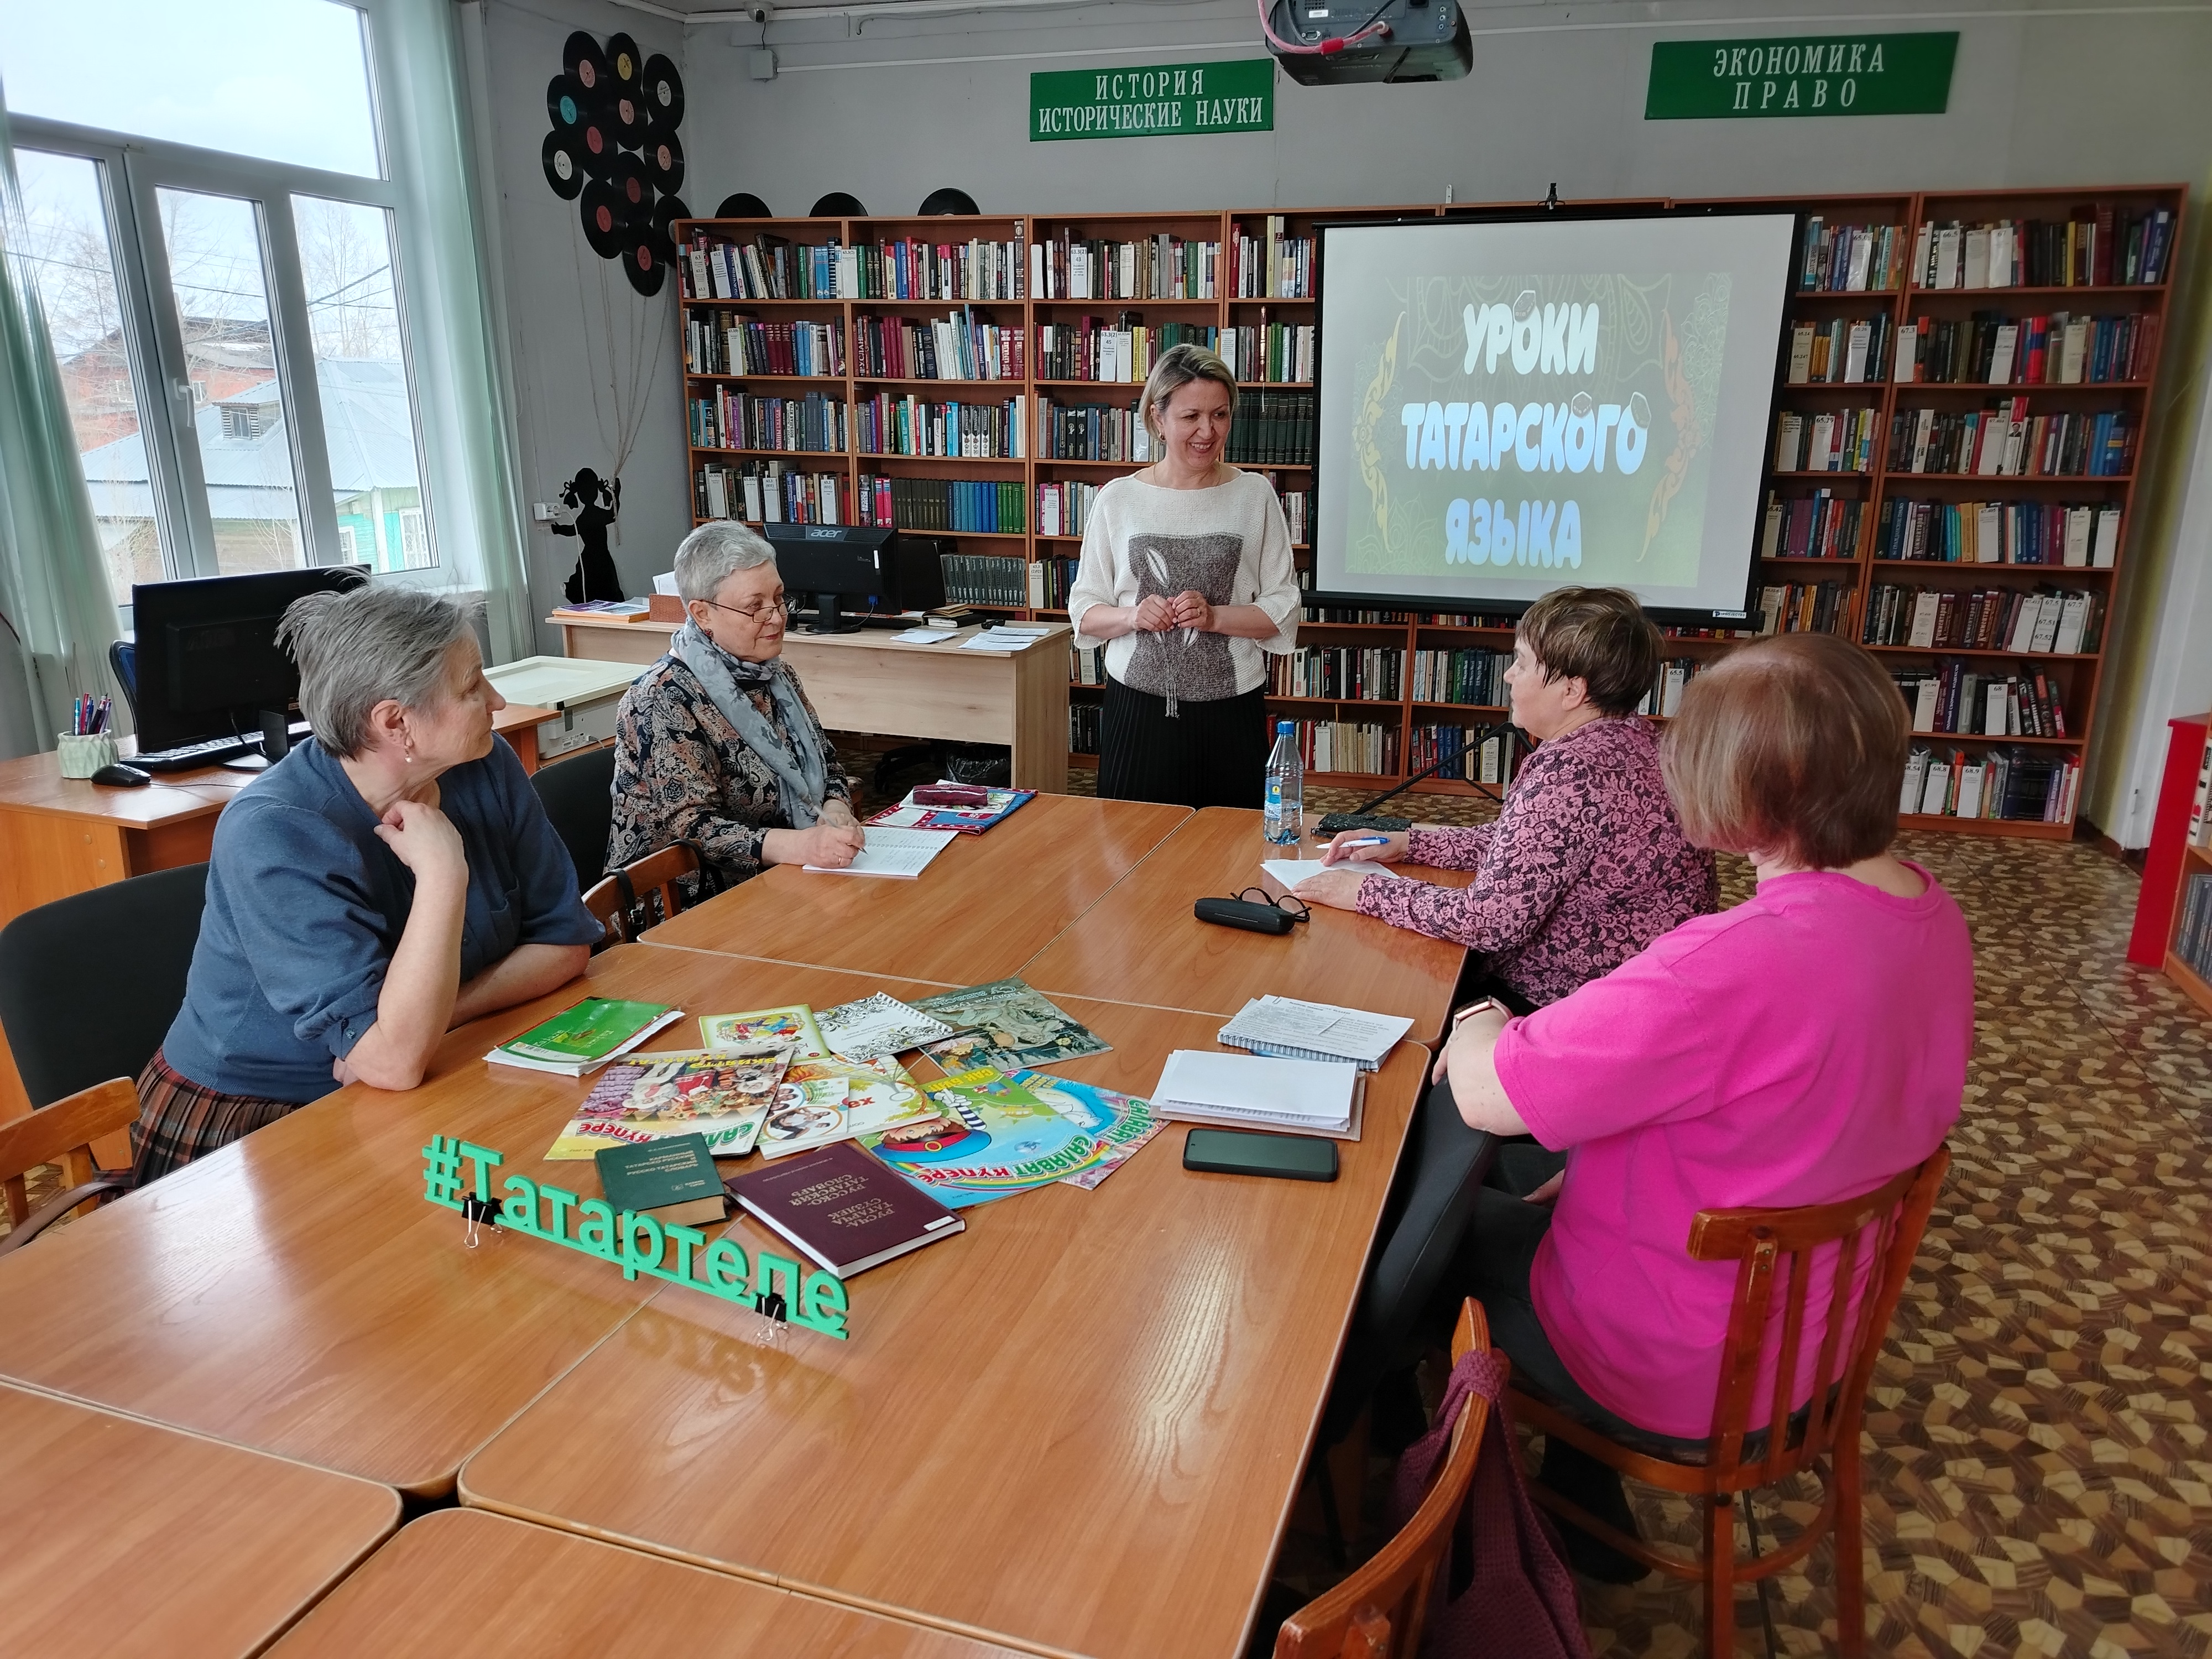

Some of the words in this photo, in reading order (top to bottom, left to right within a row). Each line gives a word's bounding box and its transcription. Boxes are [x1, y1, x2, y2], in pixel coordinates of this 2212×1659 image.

[1713, 44, 1884, 77] ЭКОНОМИКА
[1095, 70, 1204, 101] ИСТОРИЯ
[1733, 79, 1855, 109] ПРАВО
[1038, 102, 1182, 133] ИСТОРИЧЕСКИЕ
[1196, 97, 1263, 126] НАУКИ
[1463, 302, 1599, 375] УРОКИ
[1401, 401, 1650, 474] ТАТАРСКОГО
[810, 529, 842, 538] acer
[1445, 498, 1582, 569] ЯЗЫКА
[1915, 513, 1924, 555] Комментарий
[1936, 603, 1947, 641] Комментарий
[1964, 603, 1976, 644] Комментарий
[1977, 599, 1991, 643] Комментарий
[964, 1068, 994, 1084] САК
[1011, 1134, 1092, 1177] САЛАВАТ
[788, 1175, 869, 1207] ТАТАРСКИЙ
[790, 1172, 852, 1198] СЛОВАРЬ
[831, 1201, 893, 1225] ТАТАРЧА
[422, 1134, 850, 1340] #Татартеле
